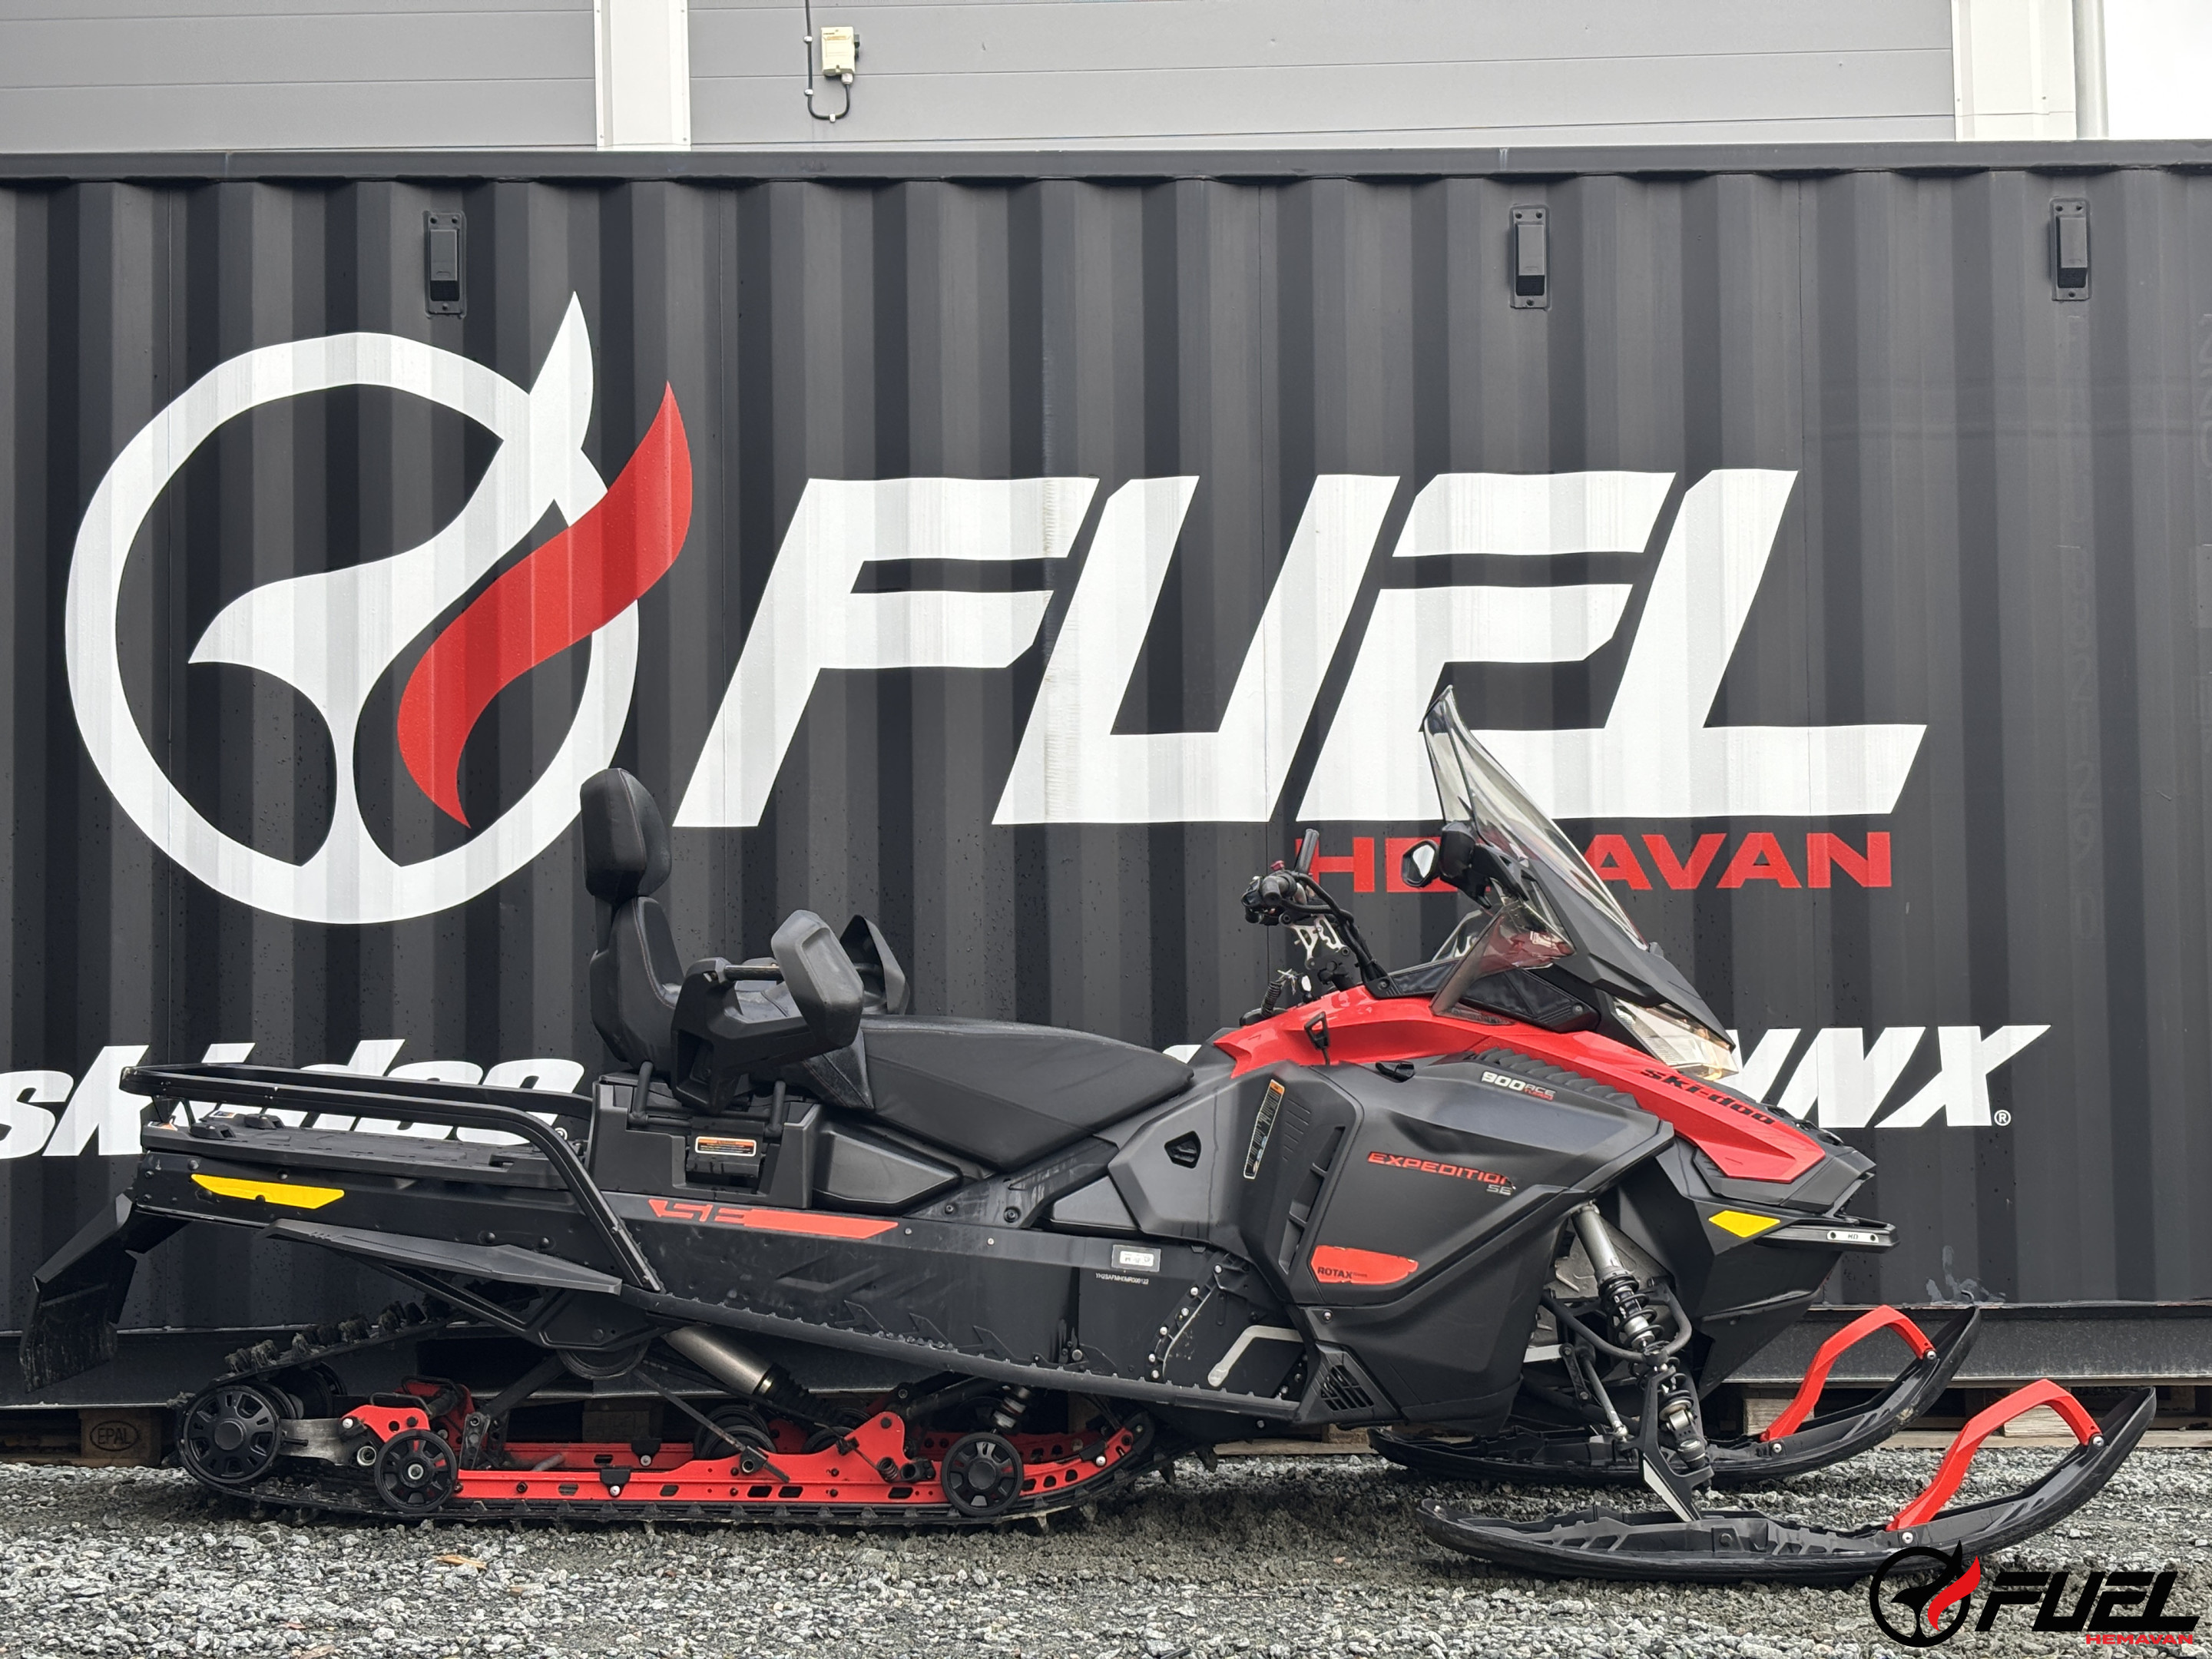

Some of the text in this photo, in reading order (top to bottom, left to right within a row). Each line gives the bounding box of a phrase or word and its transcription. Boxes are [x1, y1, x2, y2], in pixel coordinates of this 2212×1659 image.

[673, 469, 1927, 827] FUEL
[1295, 832, 1892, 892] HEAVAN
[1482, 1071, 1525, 1091] 900
[1717, 1025, 2051, 1128] YNX
[1641, 1069, 1776, 1124] ski-doo
[1486, 1184, 1512, 1196] SE
[1317, 1267, 1353, 1279] ROTAX
[98, 1428, 131, 1445] EPAL
